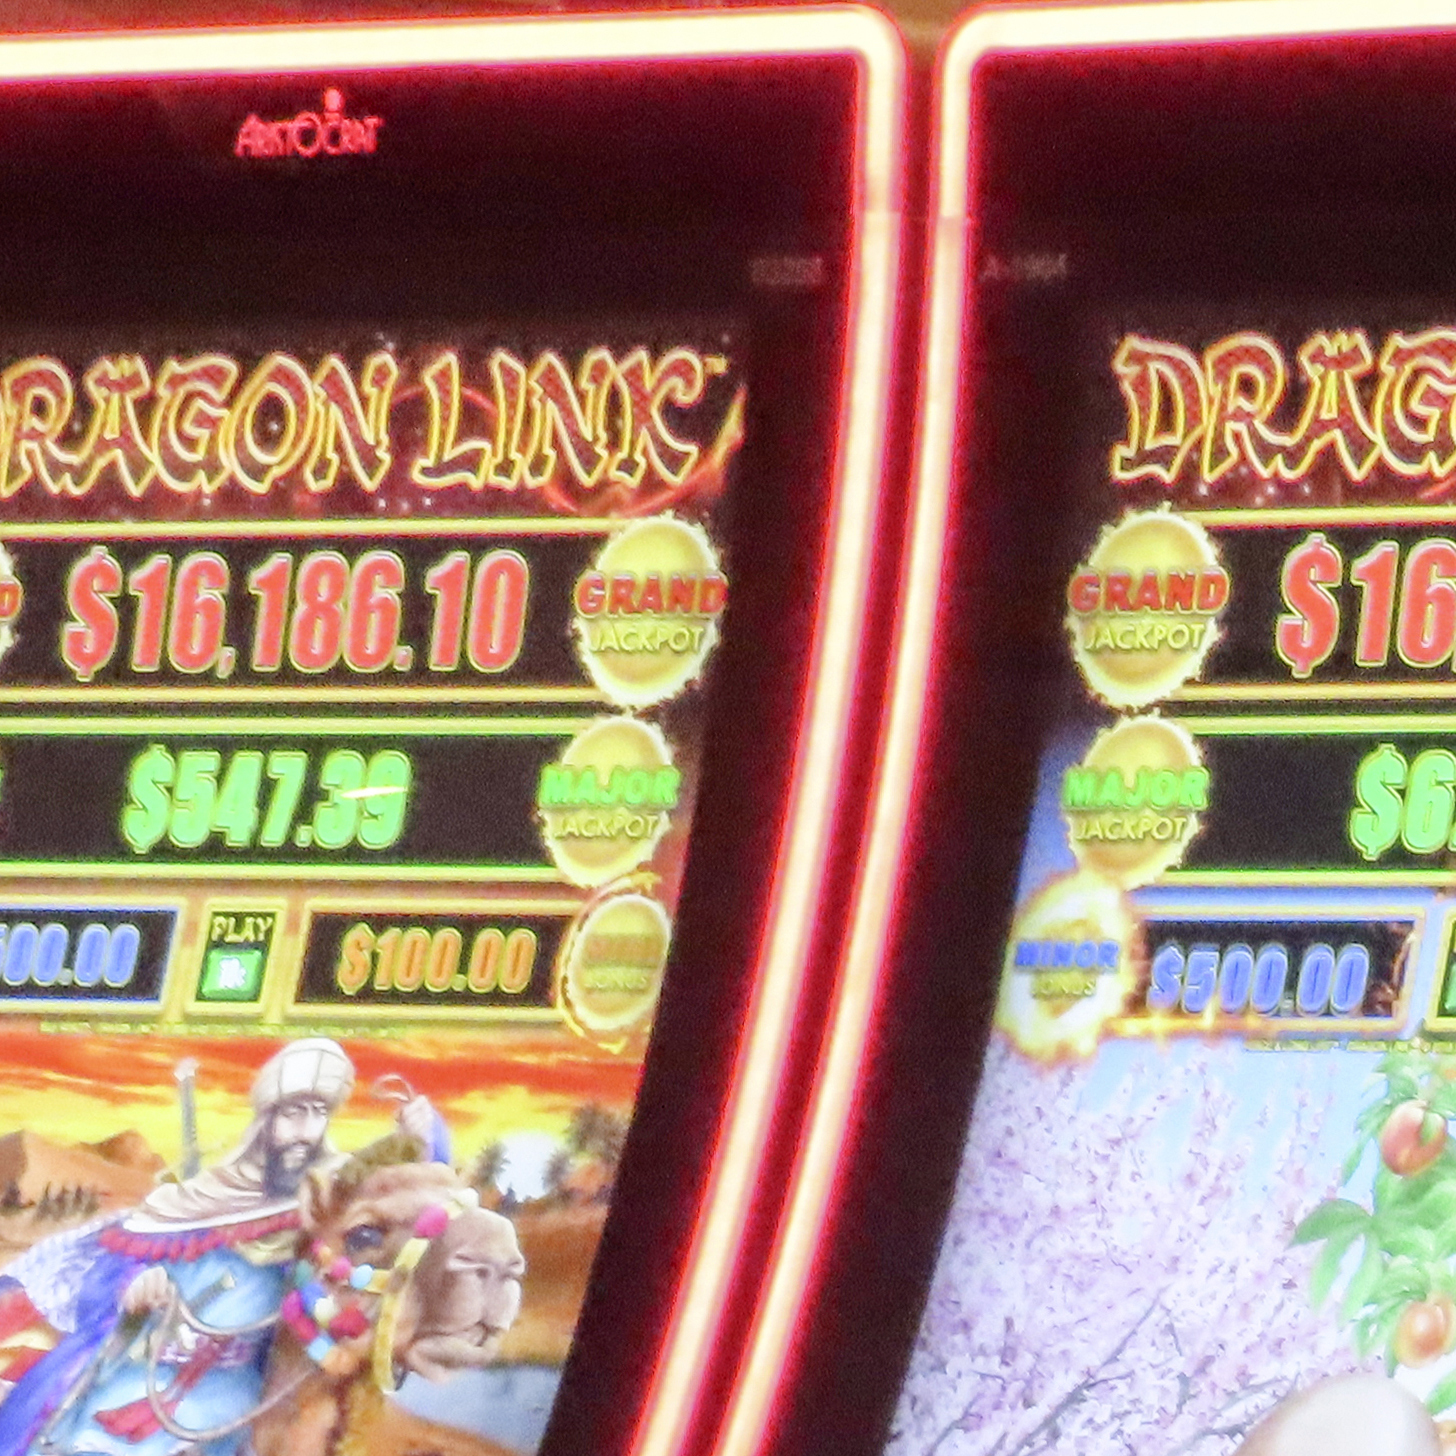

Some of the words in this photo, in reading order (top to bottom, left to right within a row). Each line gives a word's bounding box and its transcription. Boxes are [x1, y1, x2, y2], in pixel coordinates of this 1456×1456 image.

[0, 350, 399, 500] RAGON
[410, 346, 706, 493] LINK
[64, 545, 532, 681] $16,186.10
[574, 571, 728, 618] GRAND
[1067, 564, 1232, 616] GRAND
[588, 620, 709, 654] JACKPOT
[1084, 621, 1206, 651] JACKPOT
[120, 743, 412, 854] $547.39
[538, 763, 682, 807] MAJOR
[1062, 765, 1210, 811] MAJOR
[553, 812, 661, 842] JACKPOT
[1074, 811, 1191, 841] JACKPOT
[209, 915, 275, 944] PLAY
[0, 921, 140, 988] 00.00
[336, 921, 538, 996] $100.00
[1015, 939, 1120, 969] MINOR
[1147, 941, 1371, 1016] $500.00
